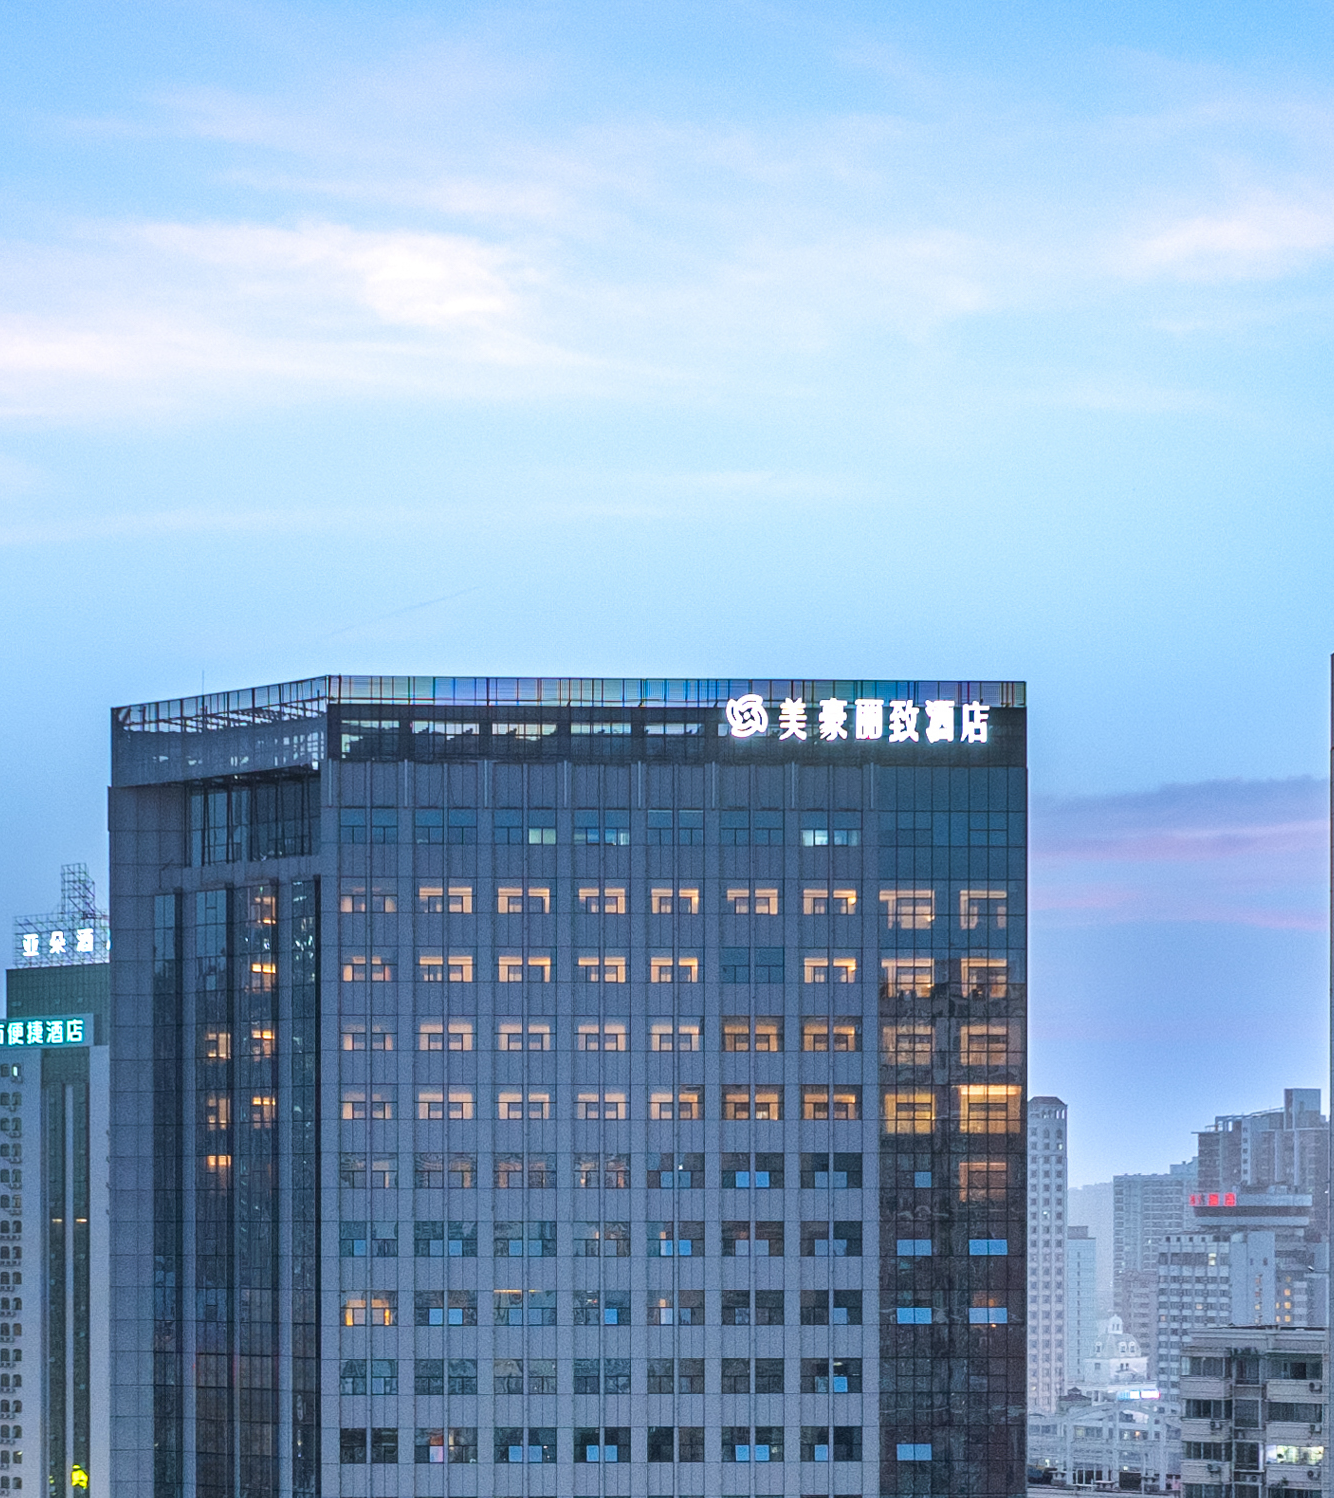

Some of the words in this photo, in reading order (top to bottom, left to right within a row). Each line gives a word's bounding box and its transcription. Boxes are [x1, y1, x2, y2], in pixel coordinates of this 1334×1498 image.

[778, 697, 990, 743] 美豪丽致酒店
[22, 928, 111, 957] 亚朵酒
